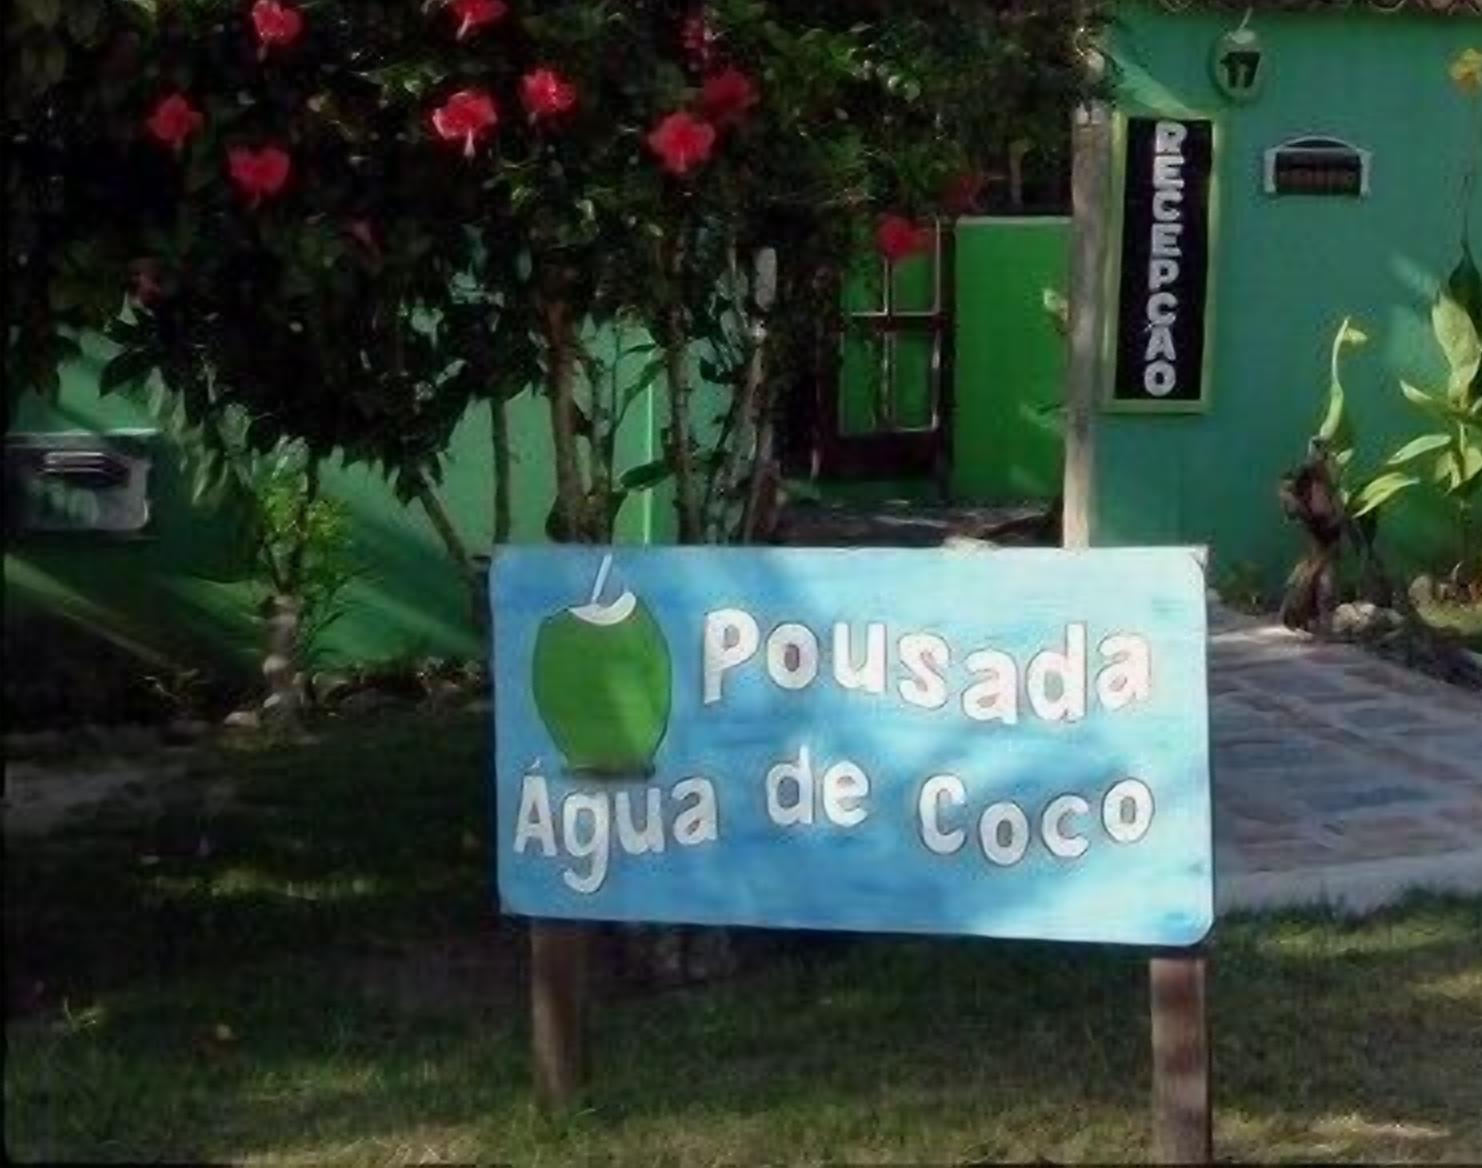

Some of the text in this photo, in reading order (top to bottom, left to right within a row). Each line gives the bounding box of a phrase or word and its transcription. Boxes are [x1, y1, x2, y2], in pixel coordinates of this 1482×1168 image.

[703, 607, 1151, 725] Pousada
[514, 745, 1154, 894] Água de Coco
